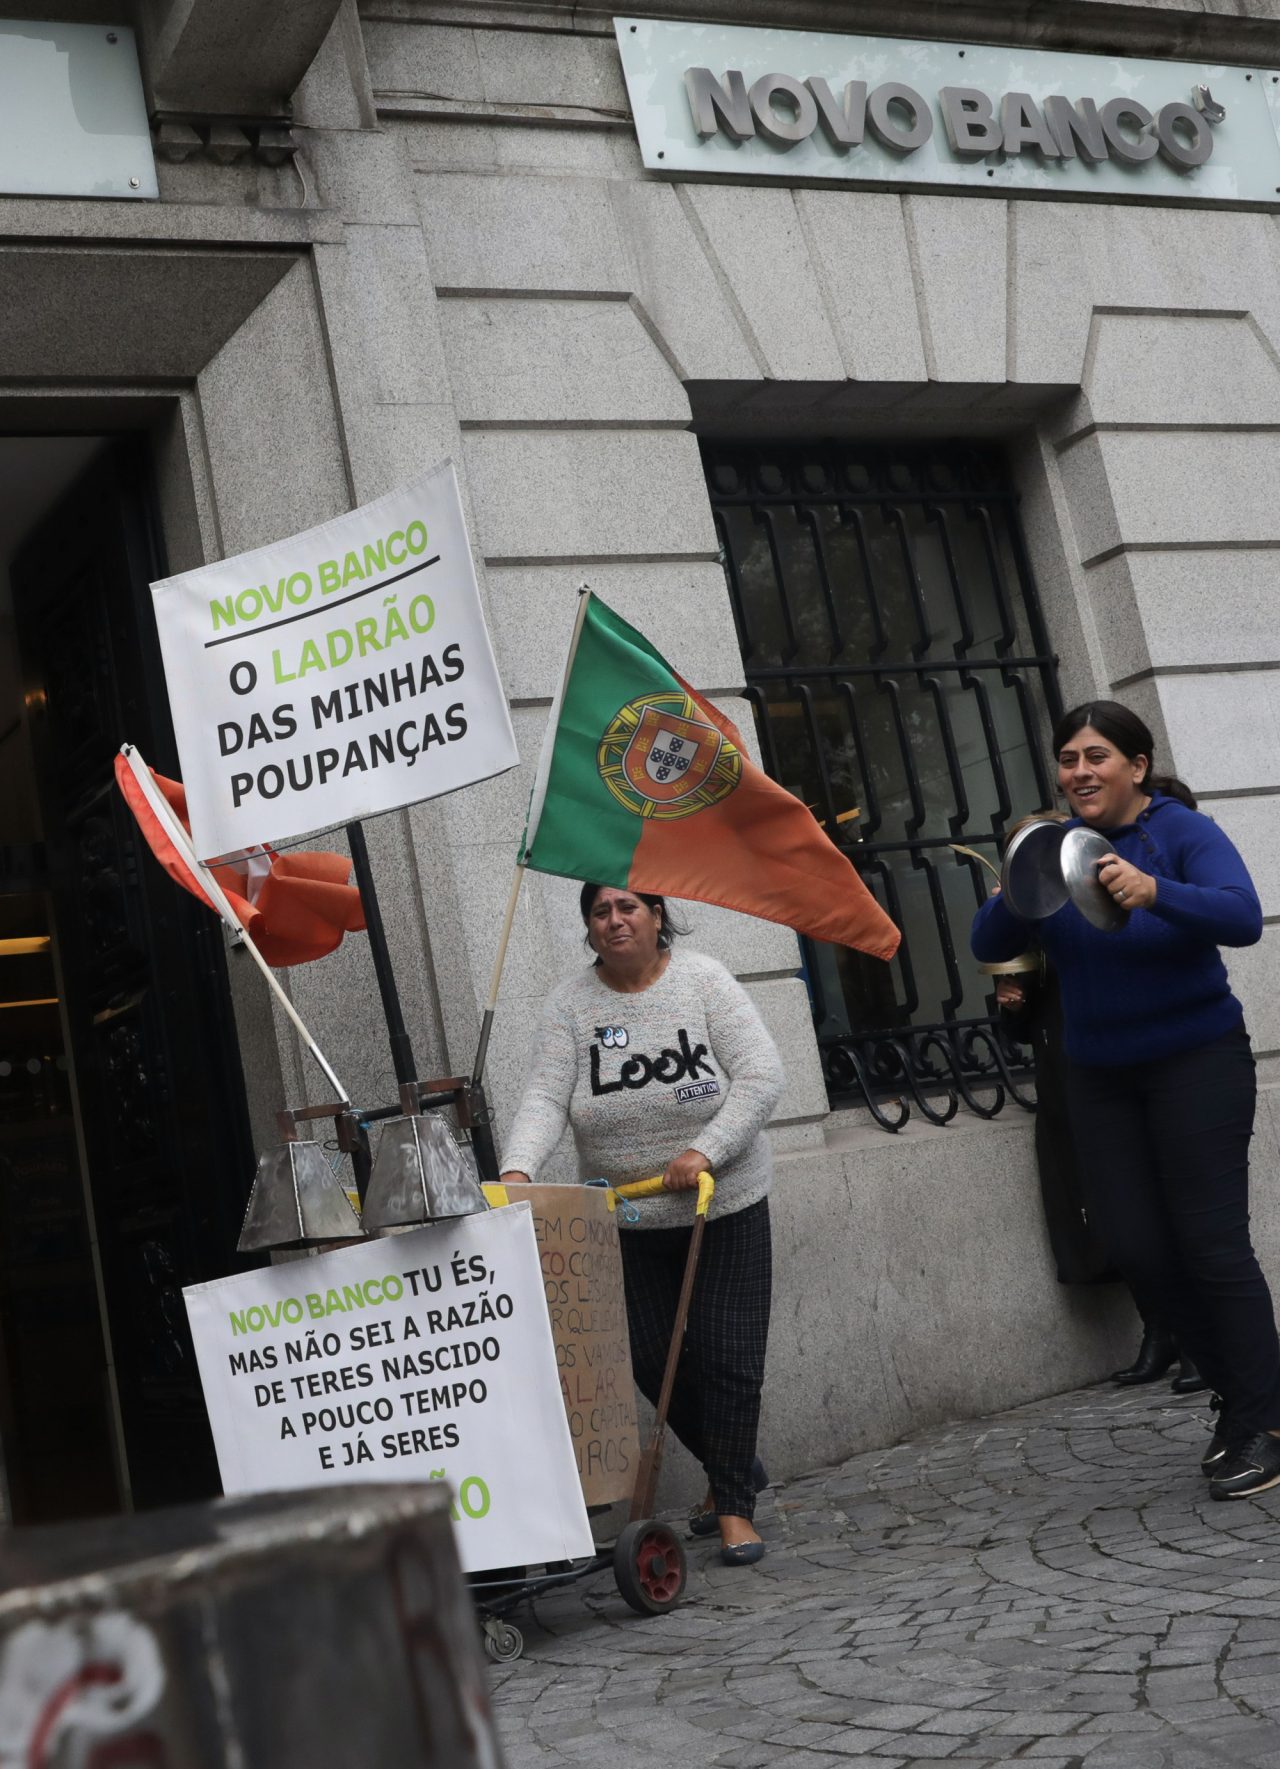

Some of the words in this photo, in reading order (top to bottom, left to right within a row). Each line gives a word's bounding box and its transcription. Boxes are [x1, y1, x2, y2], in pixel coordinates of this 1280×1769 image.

[683, 67, 933, 153] NOVO
[939, 86, 1214, 170] BANCO
[209, 571, 313, 631] NOVO
[318, 519, 428, 596] BANCO
[229, 660, 258, 696] O
[272, 593, 436, 685] LADRÃO
[217, 703, 298, 757] DAS
[311, 642, 465, 729] MINHAS
[230, 702, 469, 807] POUPANÇAS
[590, 1029, 716, 1096] Look
[680, 1082, 718, 1099] ATTENTION
[228, 1346, 278, 1376] MAS
[285, 1329, 342, 1366] NÃO
[350, 1320, 396, 1352] SEI
[403, 1316, 421, 1340] A
[427, 1291, 514, 1335] RAZÃO
[229, 1297, 304, 1336] NOVO
[307, 1274, 403, 1320] BANCO
[403, 1265, 442, 1297] TU
[451, 1250, 496, 1286] ÉS,
[254, 1381, 287, 1407] DE
[291, 1363, 374, 1400] TERES
[382, 1336, 501, 1383] NASCIDO
[280, 1416, 297, 1440] A
[302, 1396, 394, 1436] POUCO
[400, 1378, 488, 1418] TEMPO
[318, 1446, 335, 1470] E
[342, 1432, 375, 1466] JÁ
[381, 1423, 460, 1460] SERES
